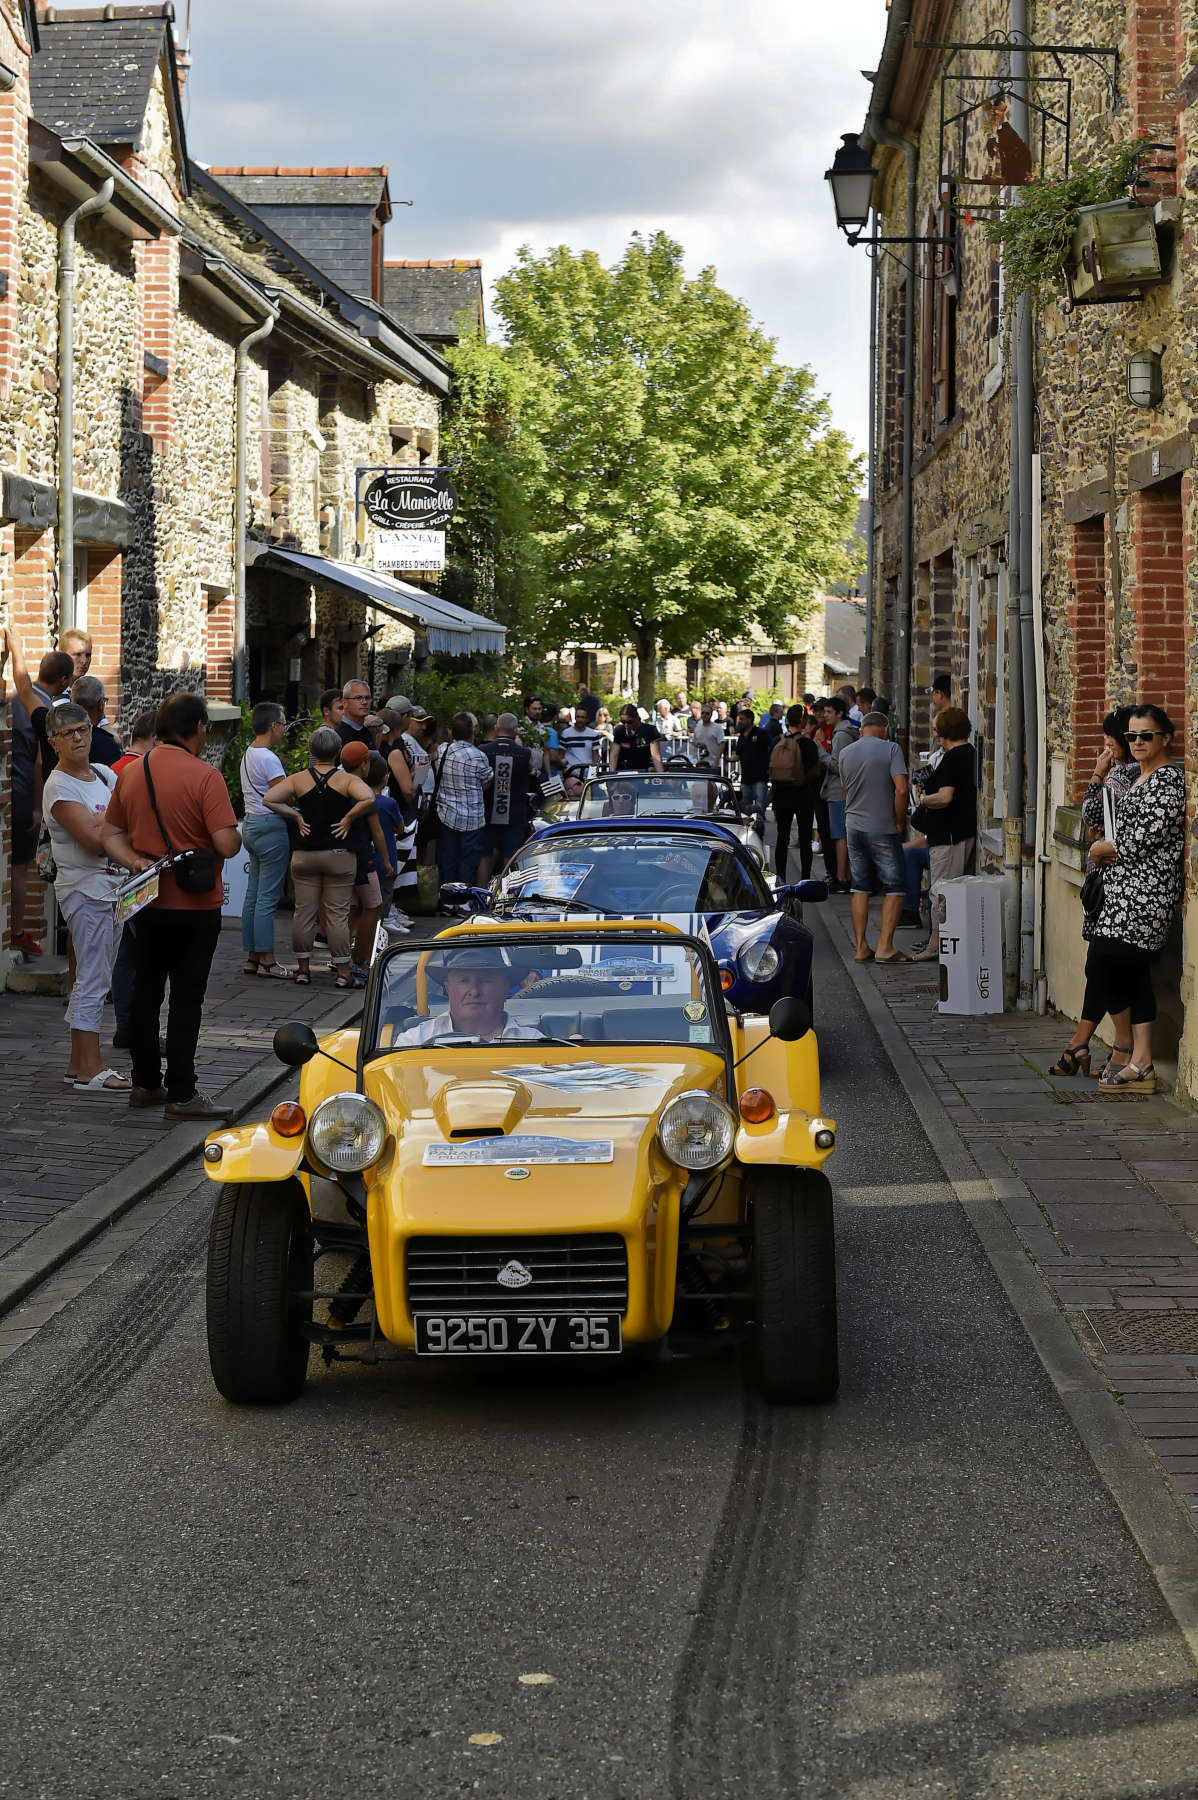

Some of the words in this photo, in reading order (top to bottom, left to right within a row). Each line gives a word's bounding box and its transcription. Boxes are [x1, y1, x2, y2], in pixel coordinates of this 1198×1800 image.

[368, 489, 388, 511] La
[391, 490, 453, 511] Manivelle
[371, 513, 390, 526] GRILL
[430, 513, 451, 526] PIZZA
[378, 560, 412, 569] CHAMBRES
[426, 1318, 509, 1351] 9250
[517, 1317, 557, 1350] ZY
[569, 1317, 610, 1350] 35
